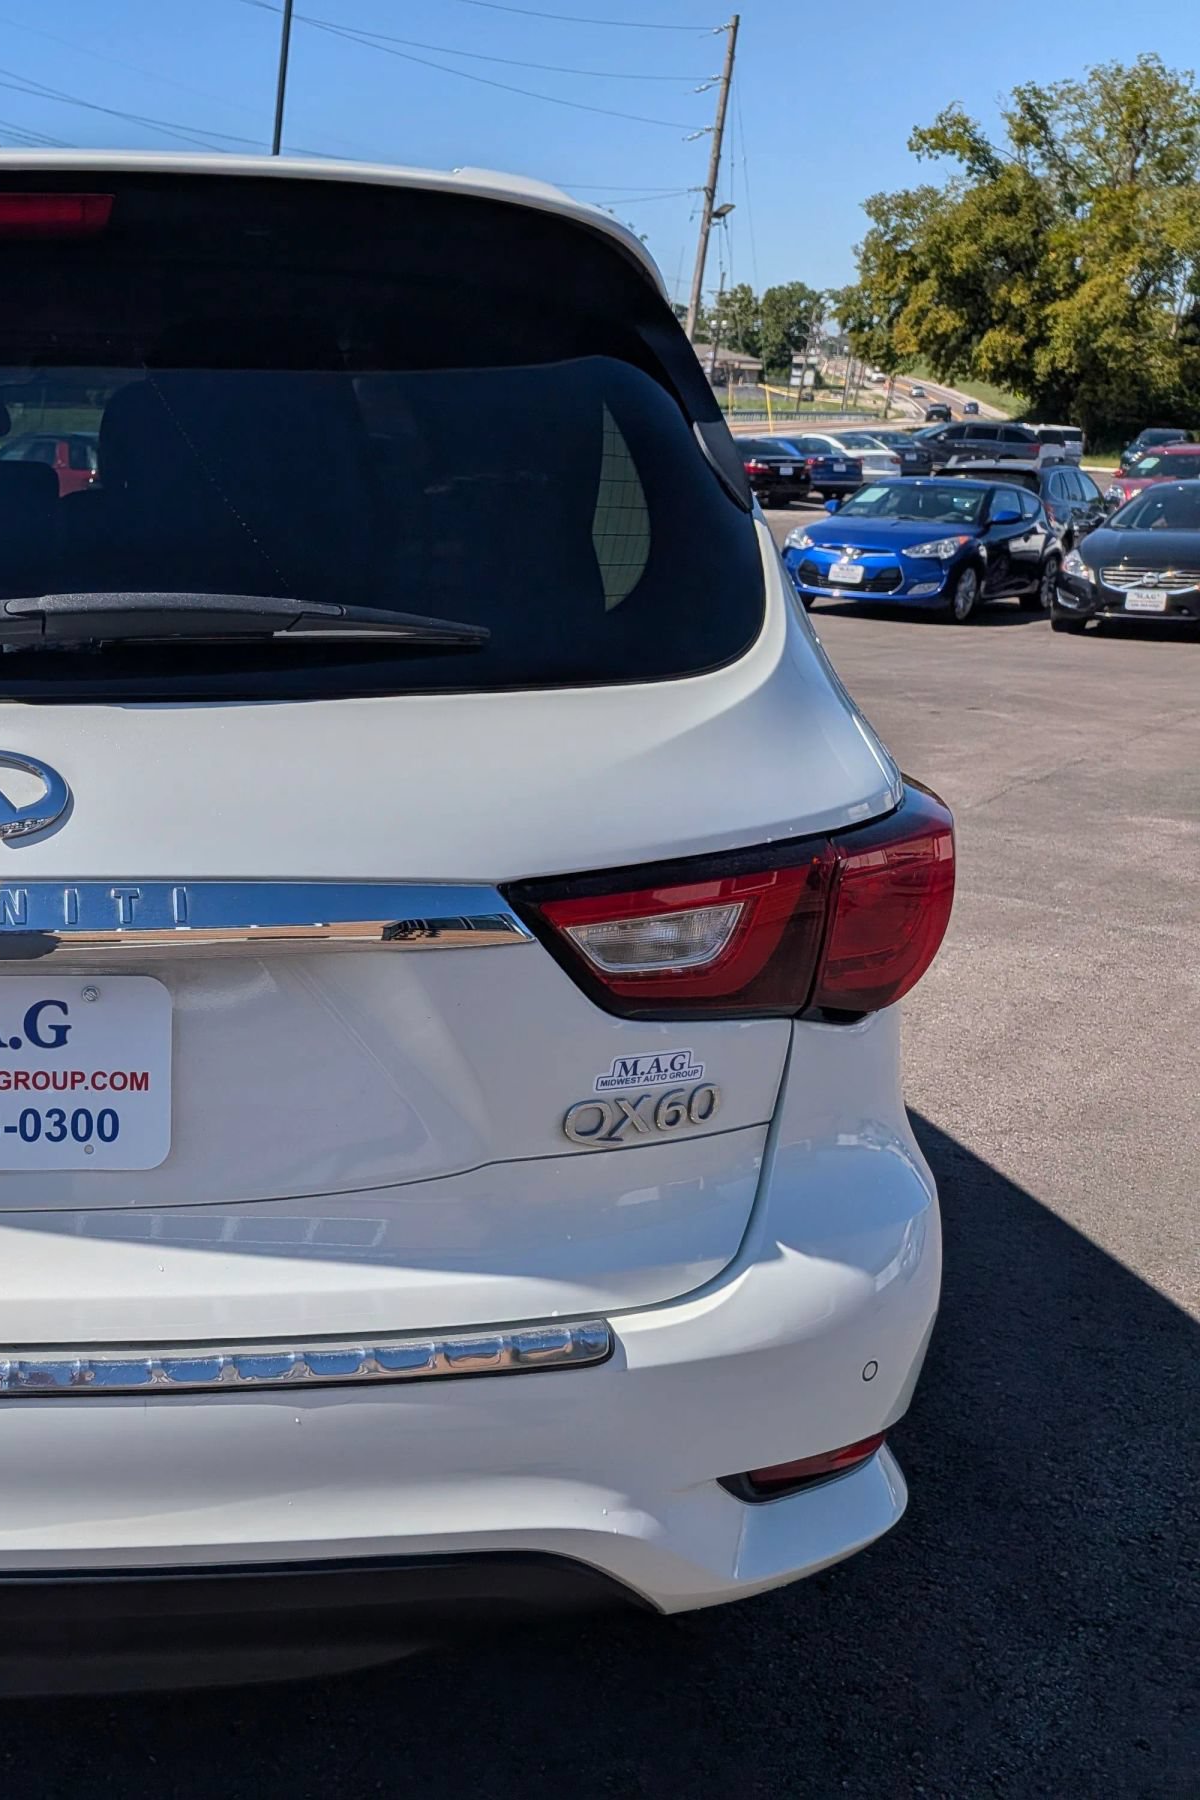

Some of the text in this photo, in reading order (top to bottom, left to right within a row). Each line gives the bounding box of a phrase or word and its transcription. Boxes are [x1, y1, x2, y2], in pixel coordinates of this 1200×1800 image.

[599, 1068, 700, 1088] MIDWEST AUTO GROUP
[618, 1053, 687, 1078] M.A.G
[562, 1082, 722, 1150] QX60
